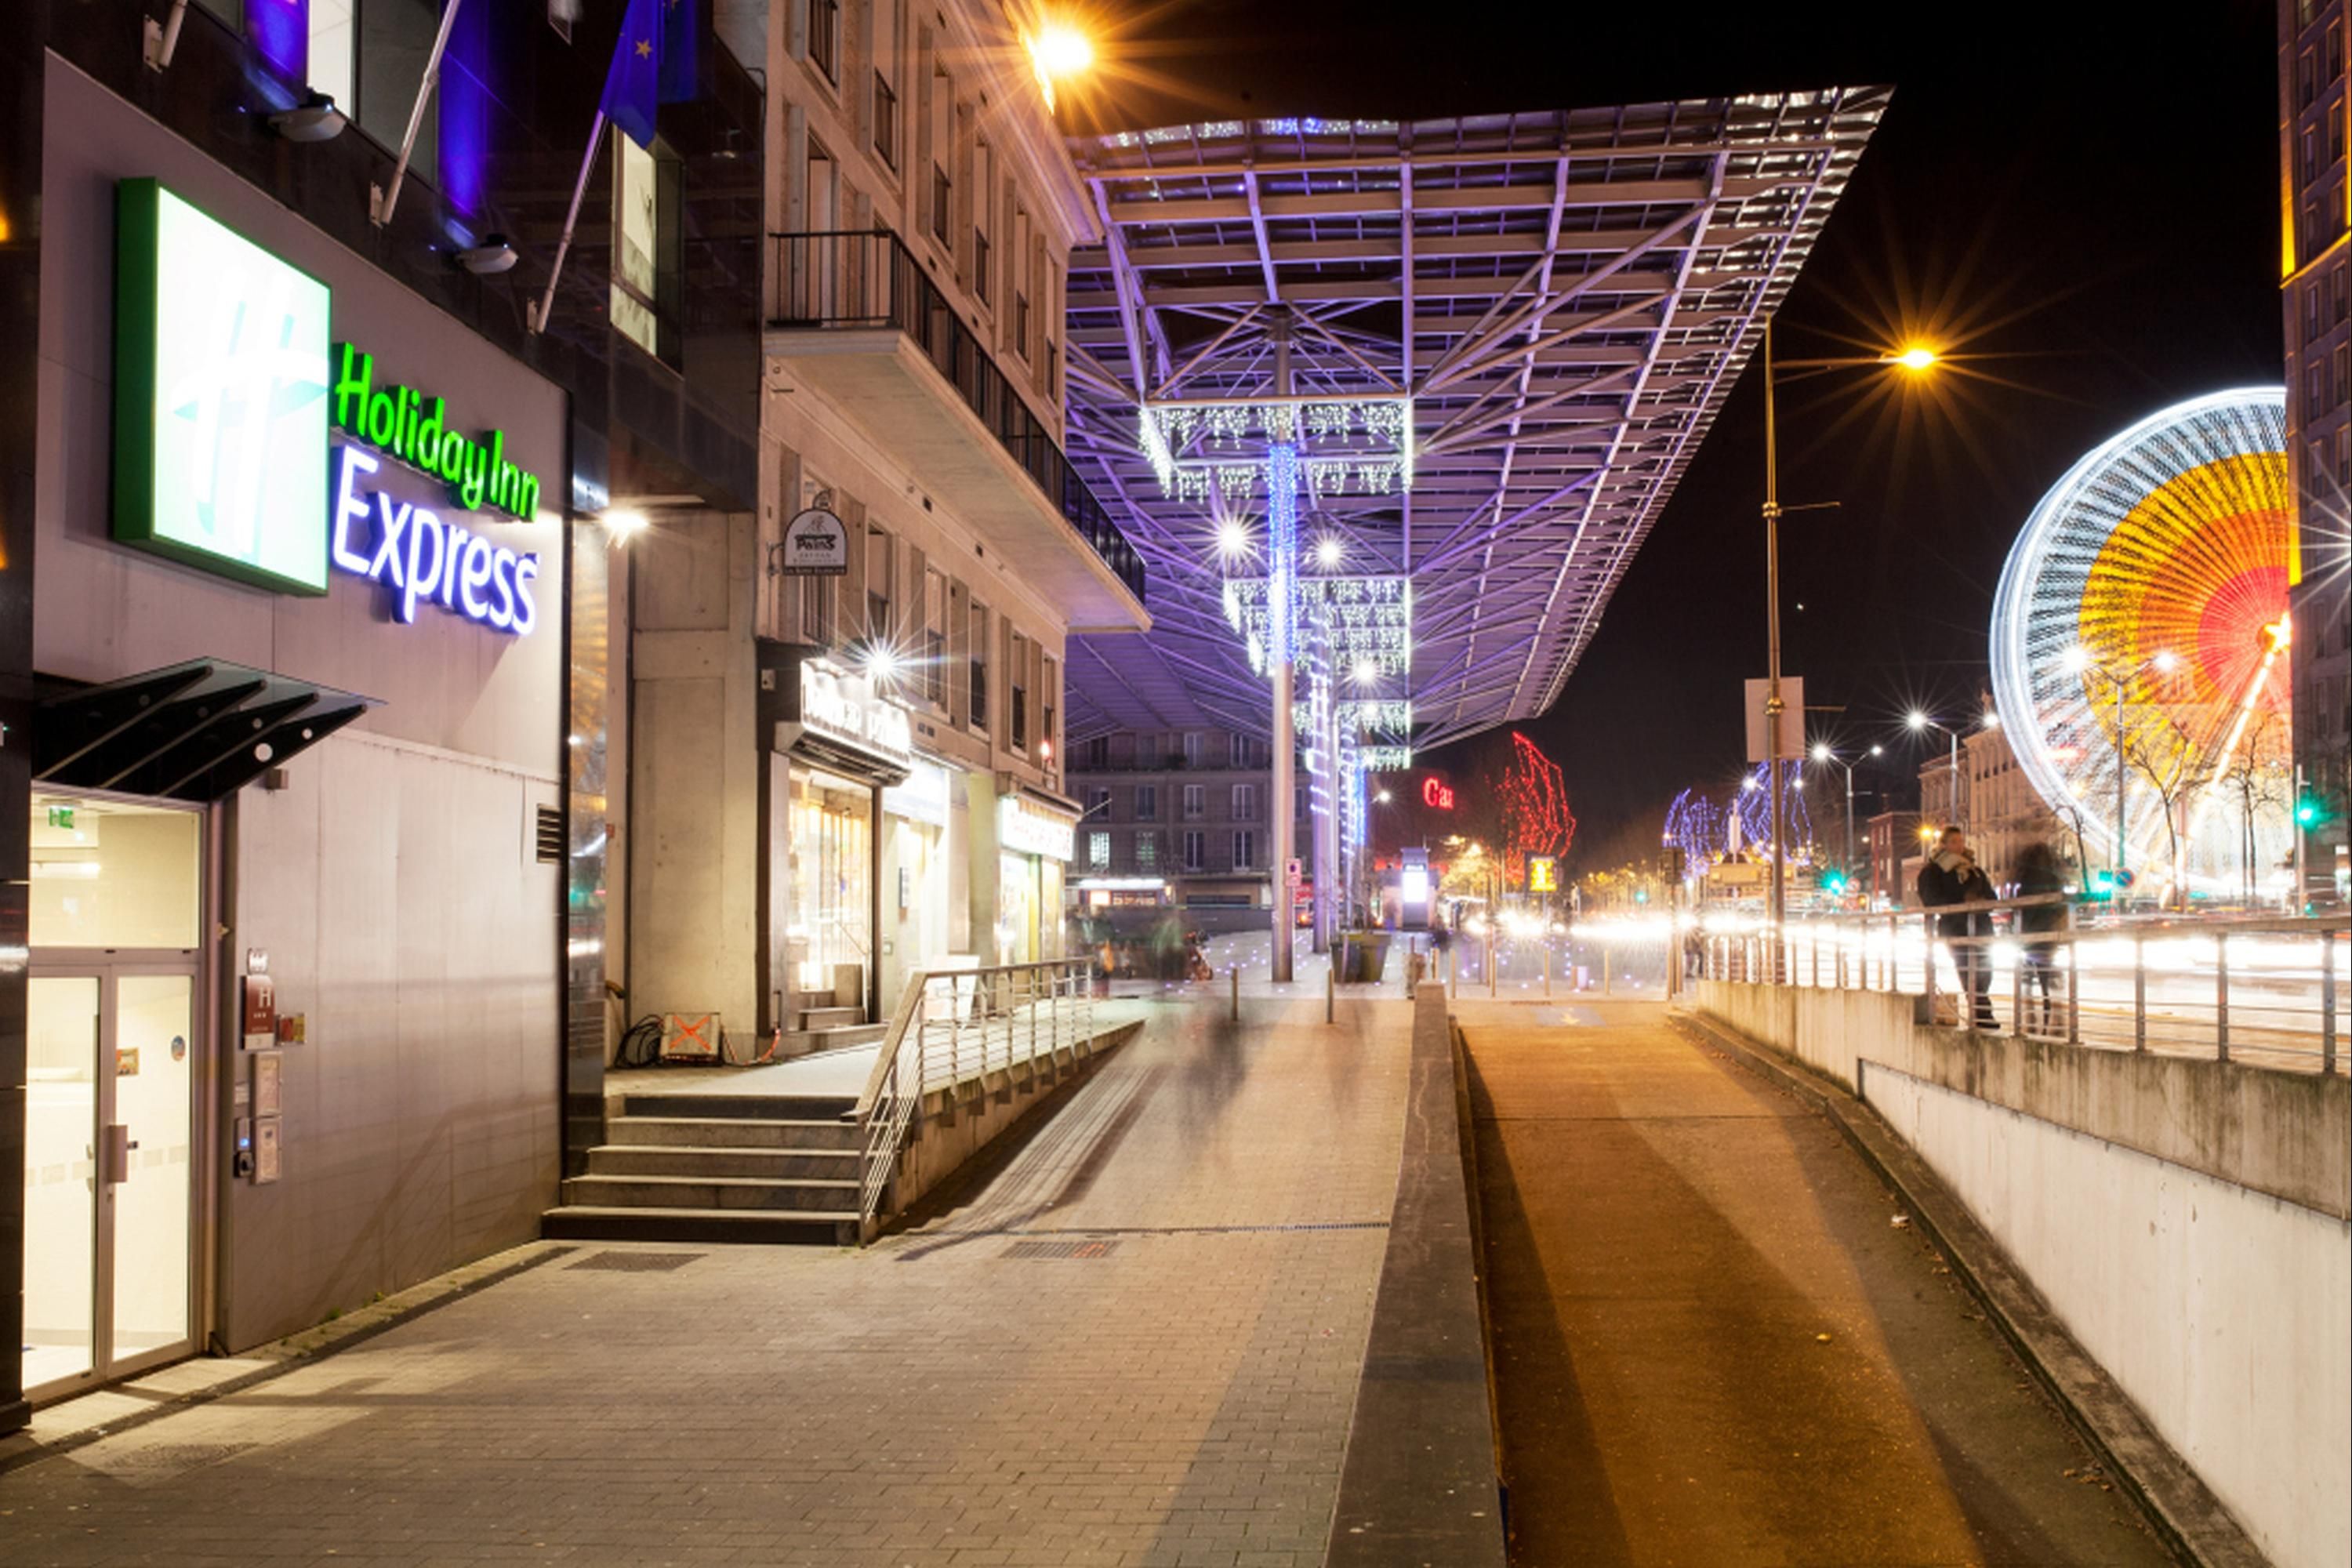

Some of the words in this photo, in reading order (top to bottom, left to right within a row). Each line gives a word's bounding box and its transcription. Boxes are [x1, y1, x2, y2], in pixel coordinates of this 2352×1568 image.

[335, 342, 487, 510] Holiday
[489, 429, 539, 522] Inn
[333, 445, 539, 636] Express
